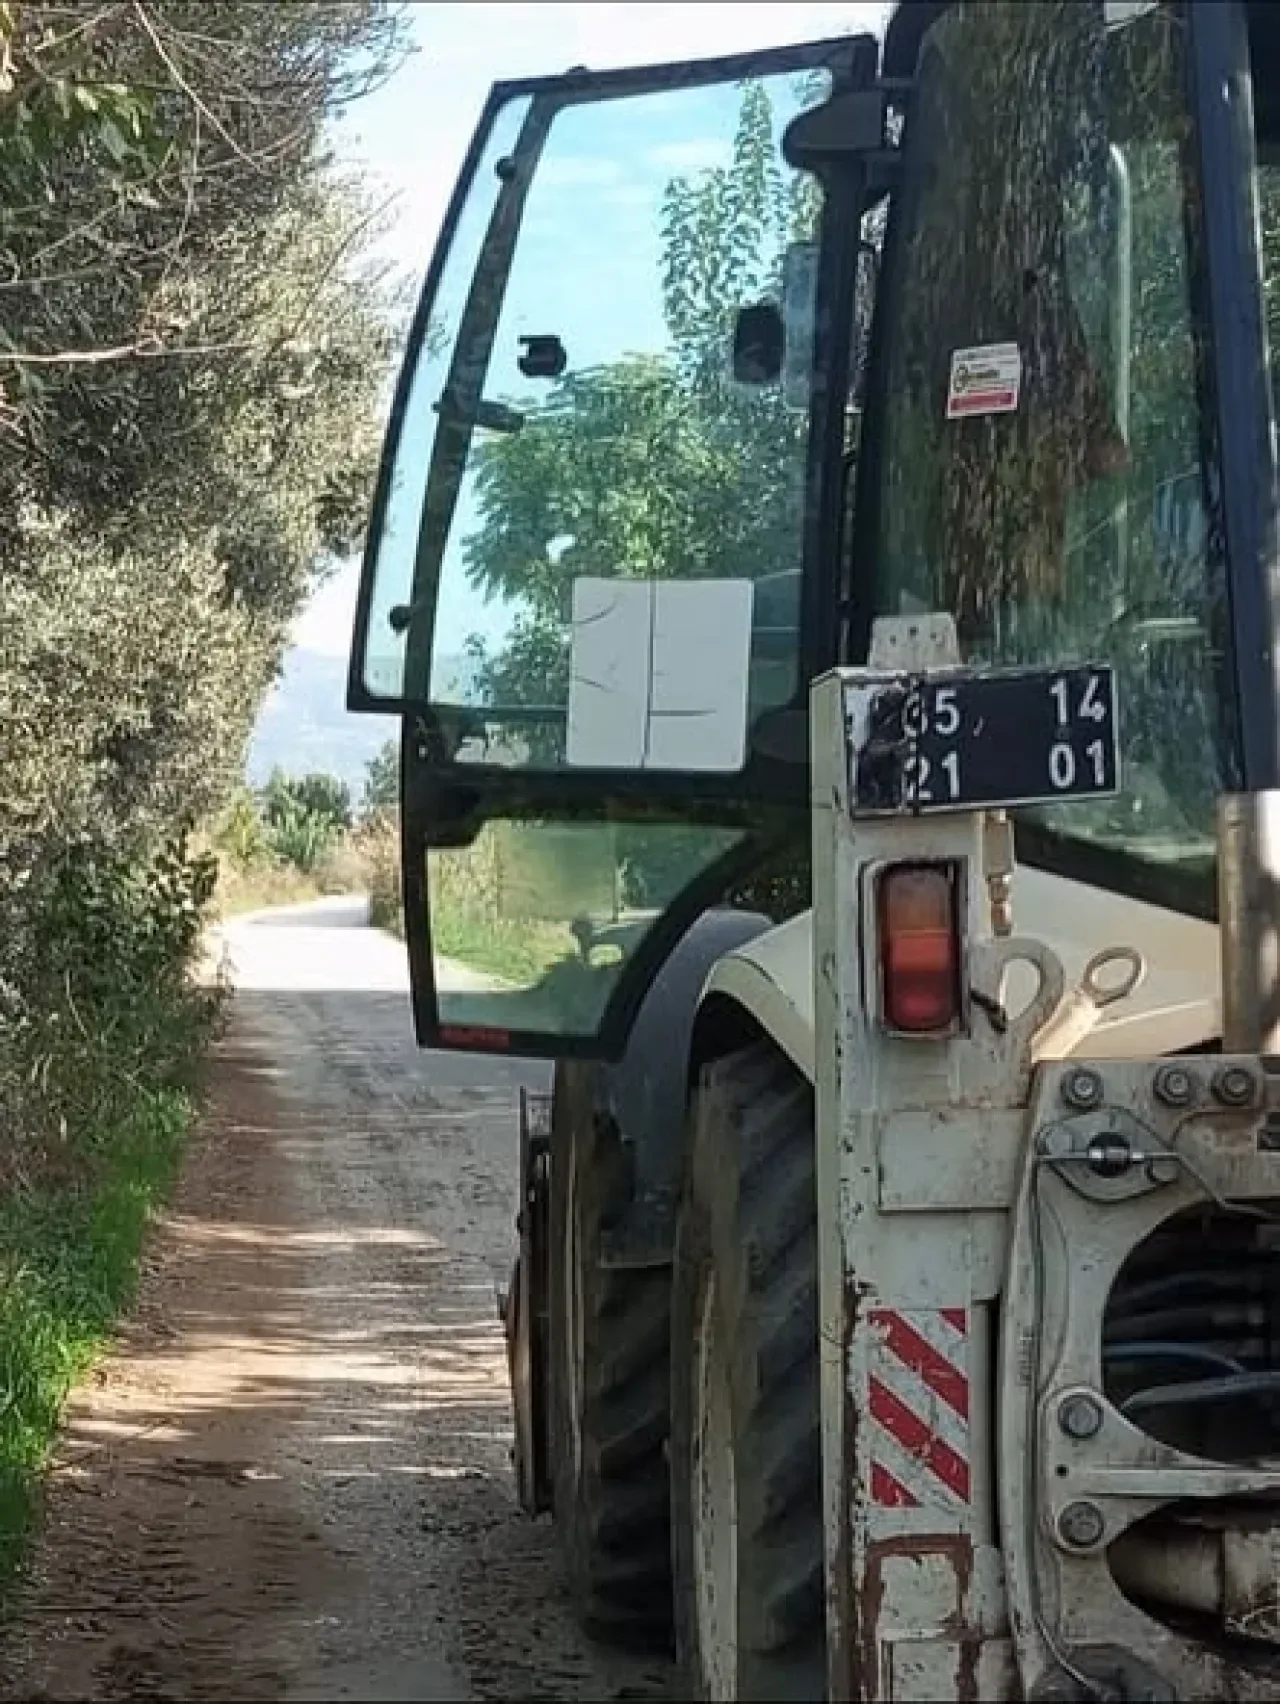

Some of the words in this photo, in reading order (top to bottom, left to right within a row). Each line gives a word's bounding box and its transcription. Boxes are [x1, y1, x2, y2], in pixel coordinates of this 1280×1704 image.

[1049, 675, 1107, 725] 14
[904, 750, 960, 801] 21
[1049, 738, 1106, 789] 01
